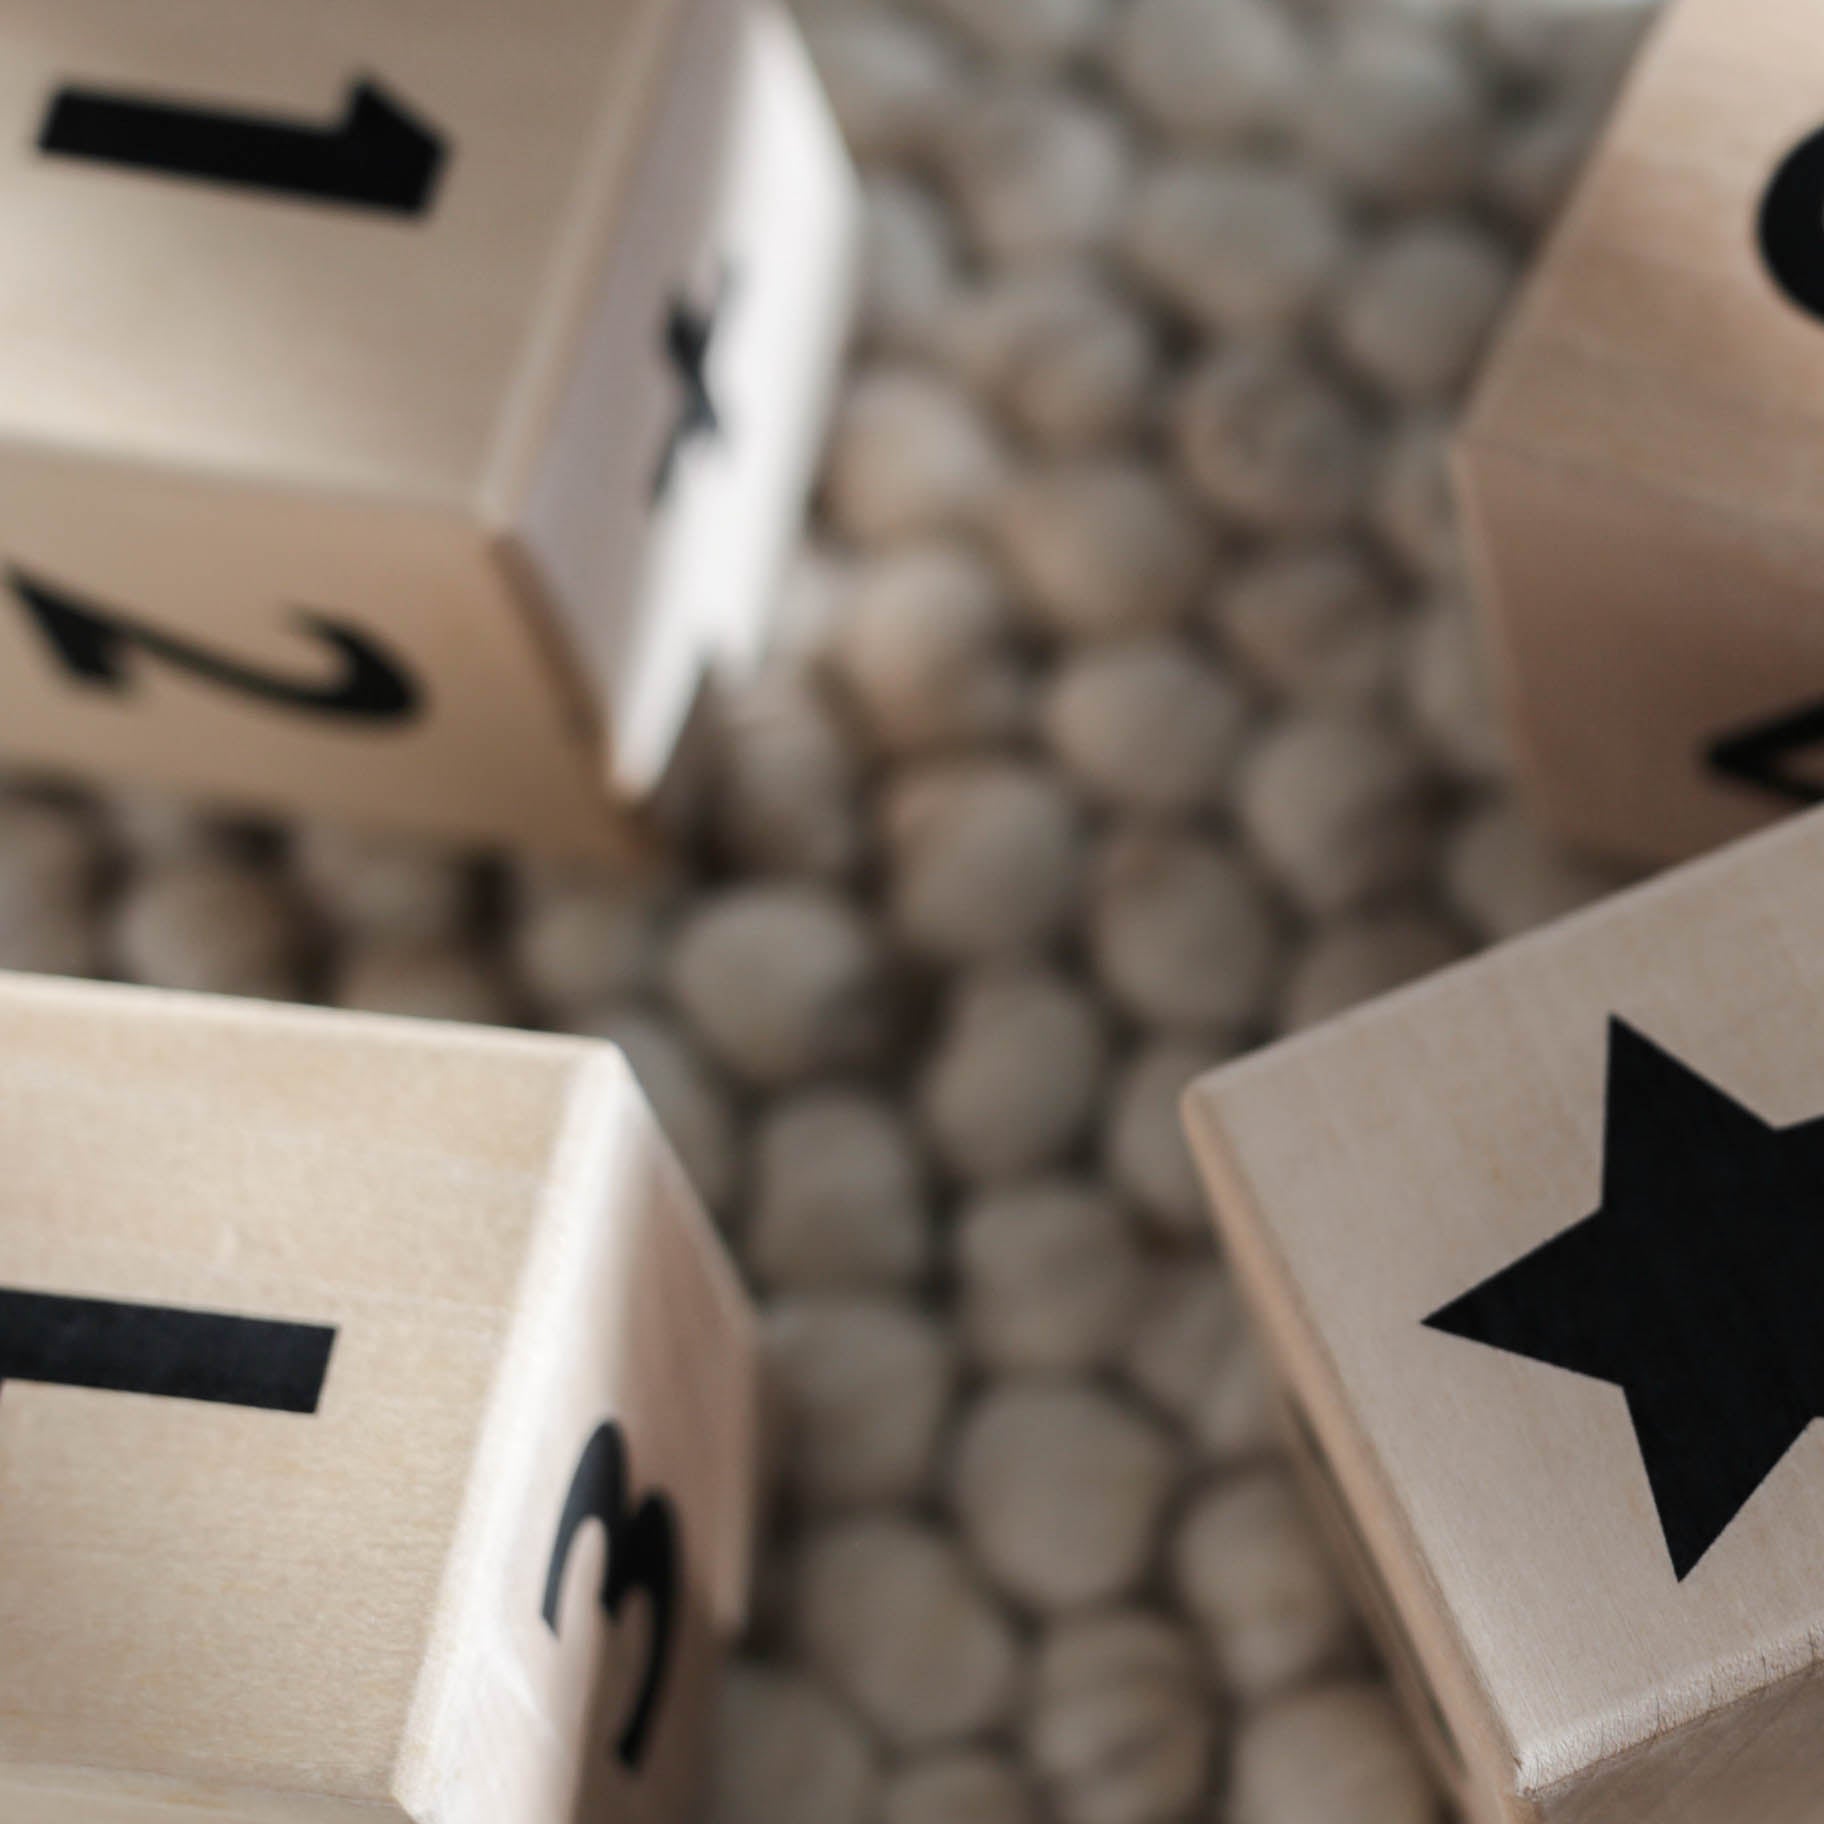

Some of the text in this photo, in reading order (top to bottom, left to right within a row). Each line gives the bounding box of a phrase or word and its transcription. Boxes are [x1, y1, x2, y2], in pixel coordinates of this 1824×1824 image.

[36, 72, 453, 224] 1
[3, 566, 425, 737] 2
[542, 1418, 681, 1773] 3
